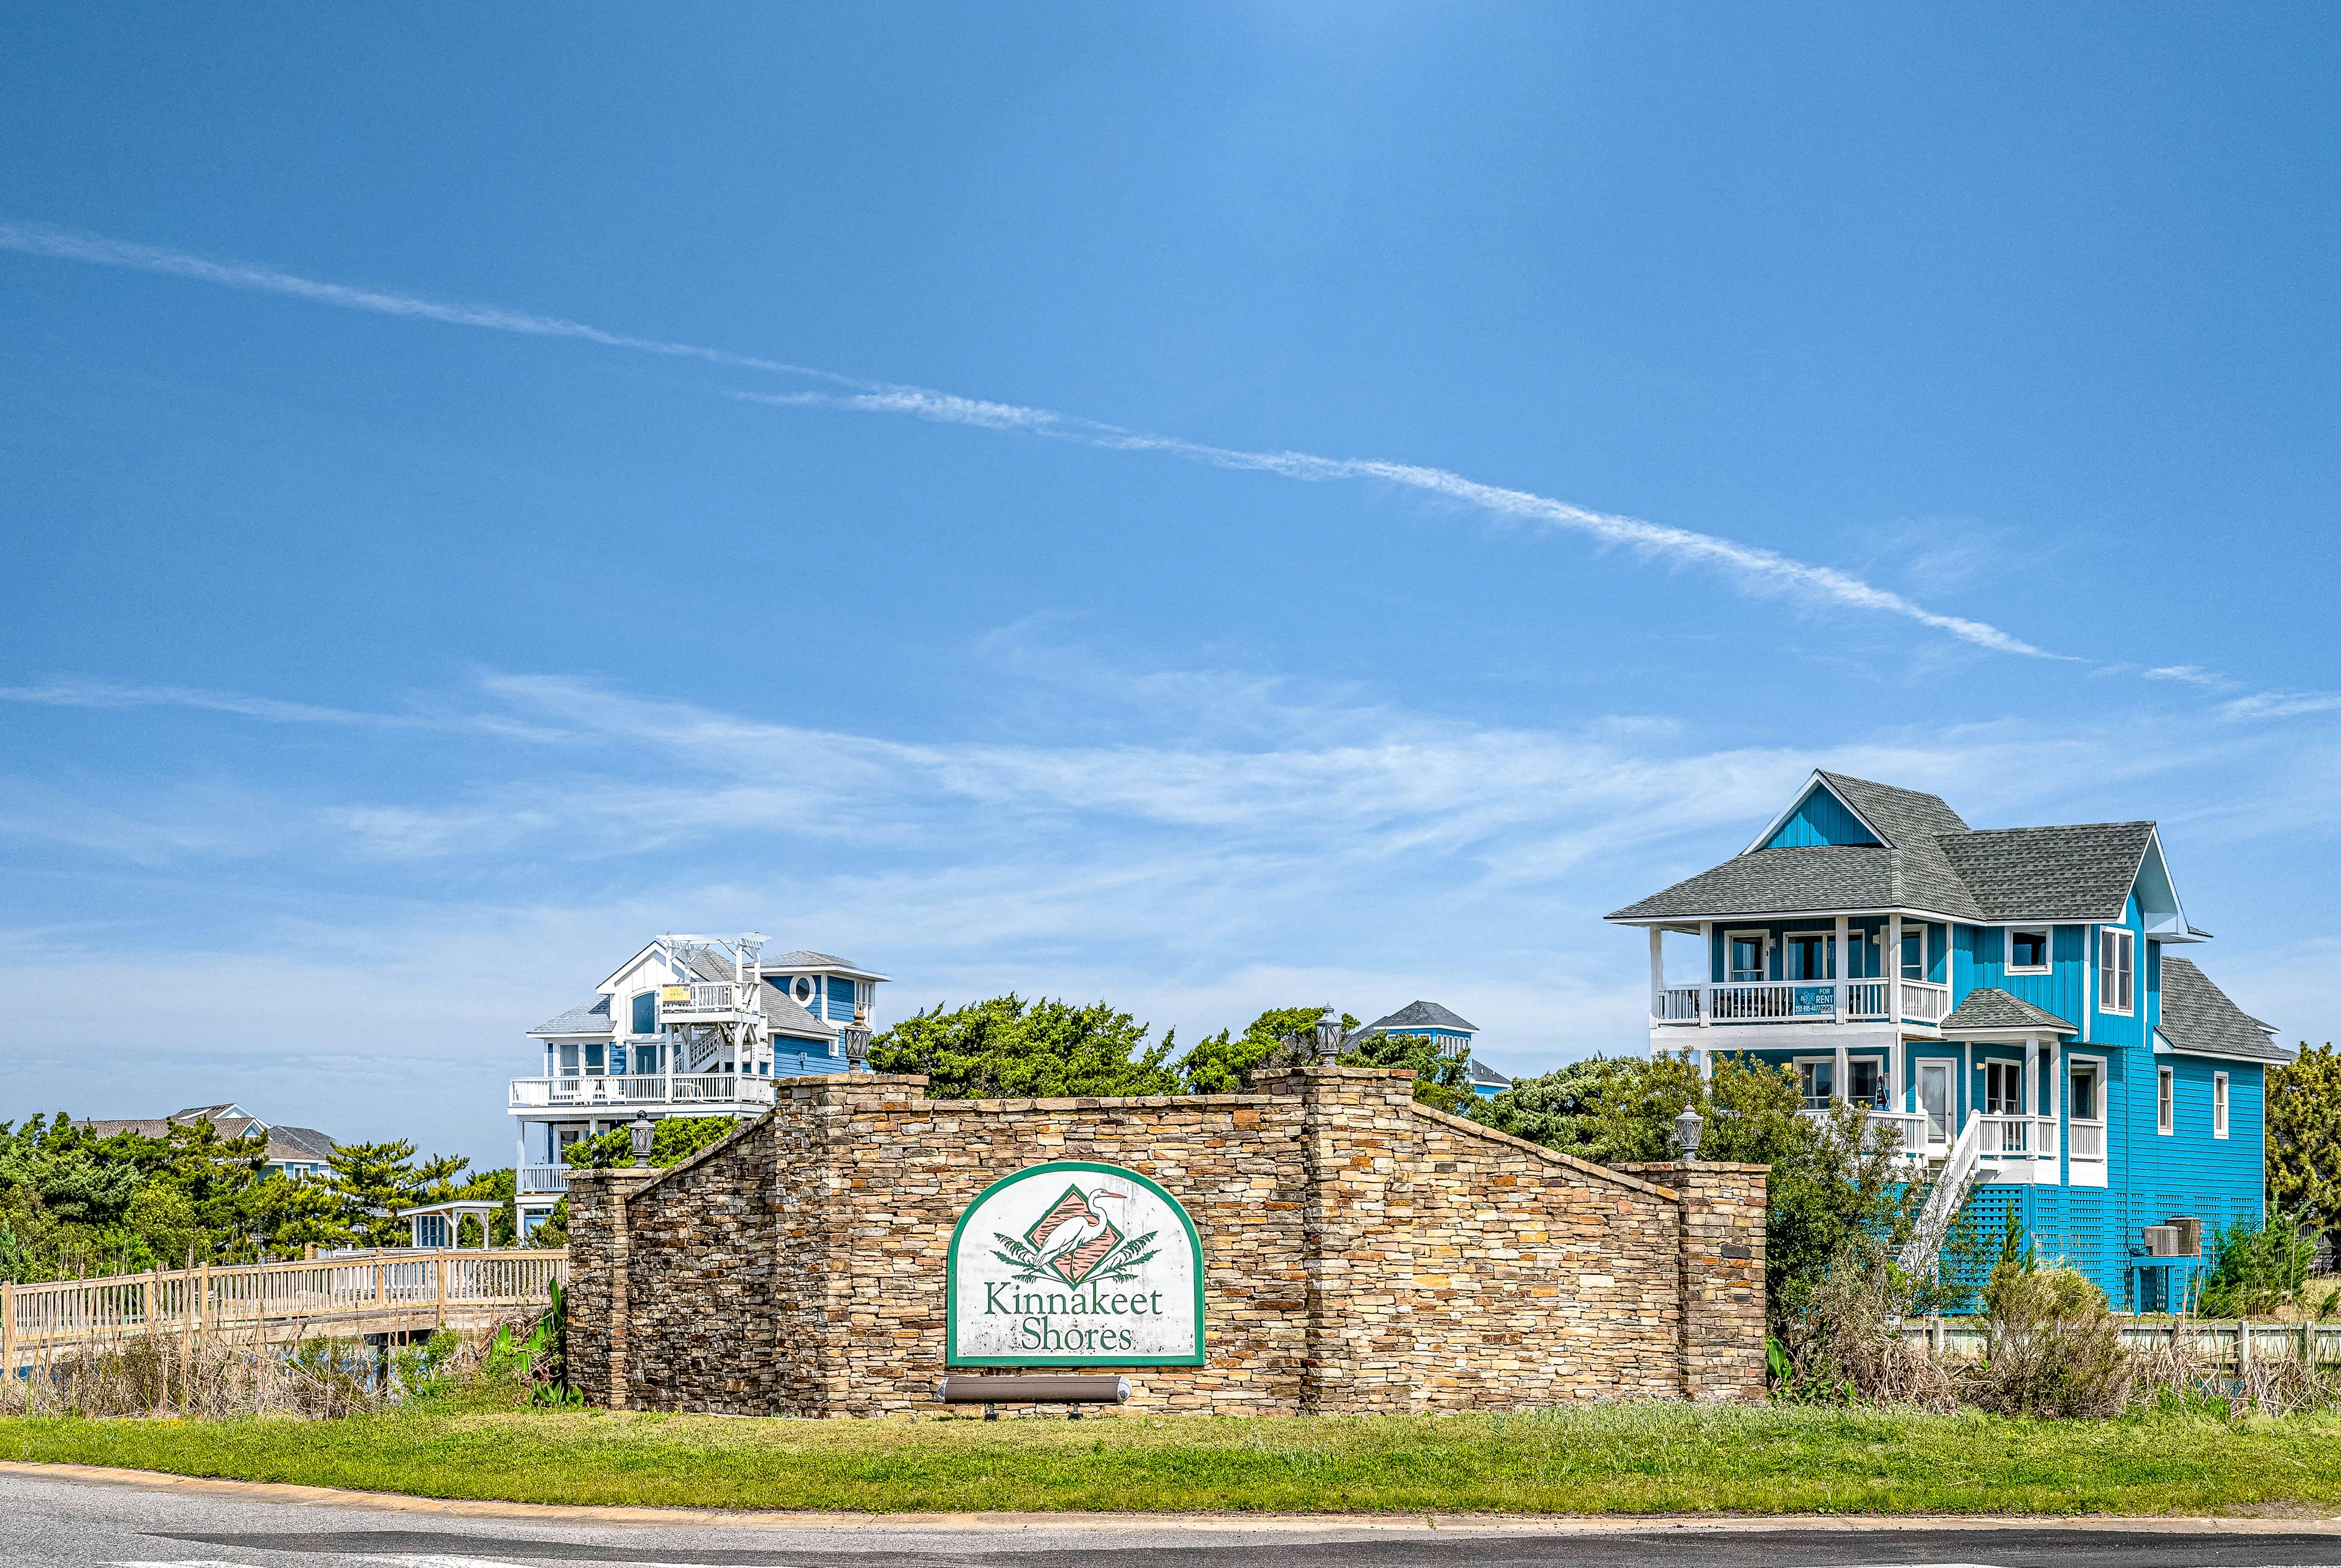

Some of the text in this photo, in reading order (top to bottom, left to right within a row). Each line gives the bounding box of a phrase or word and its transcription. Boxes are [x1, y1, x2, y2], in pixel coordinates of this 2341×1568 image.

[1816, 995, 1833, 1004] RENT
[984, 1280, 1163, 1315] Kinnakeet
[1021, 1315, 1132, 1351] Shores
